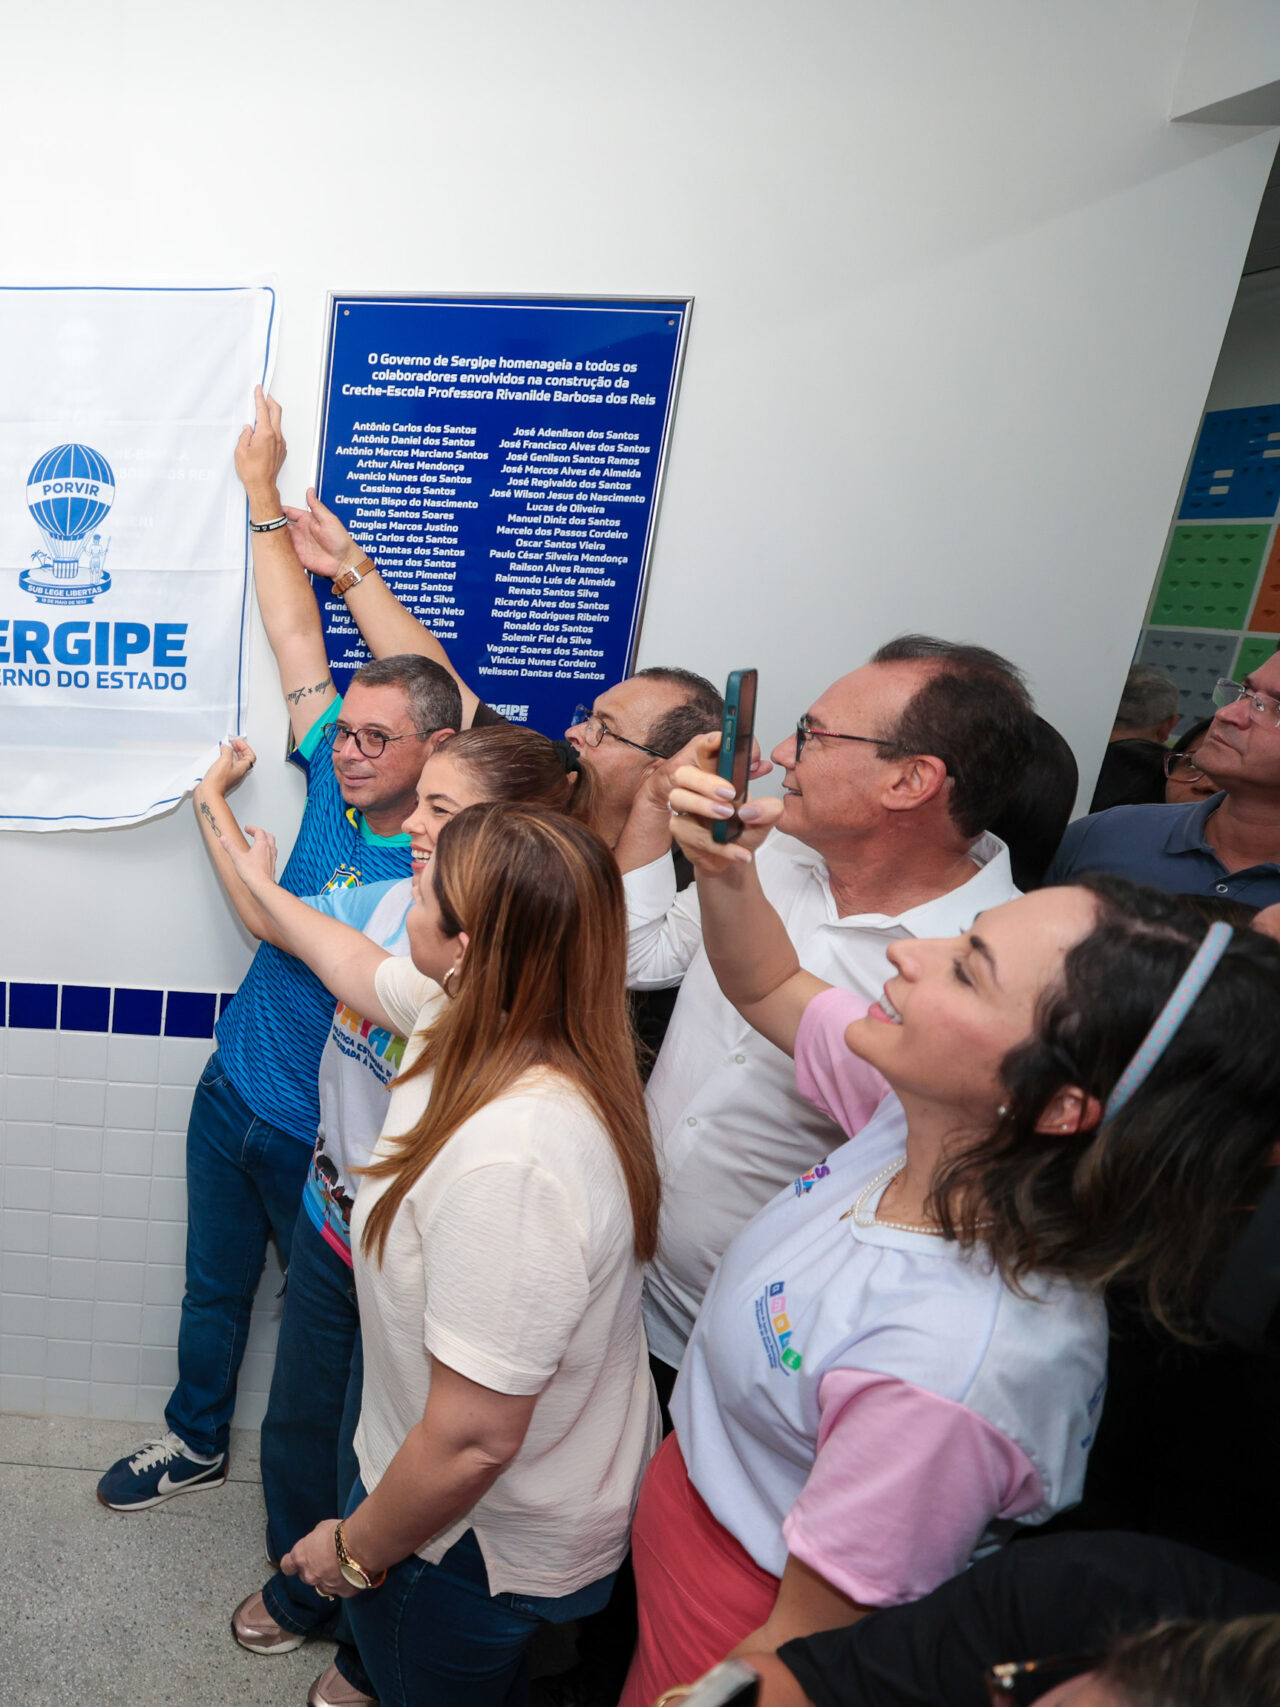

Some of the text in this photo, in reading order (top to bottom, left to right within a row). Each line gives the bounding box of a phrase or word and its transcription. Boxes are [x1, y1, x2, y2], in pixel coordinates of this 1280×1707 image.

[367, 353, 637, 373] O Governo de Sergipe homenageia a todos os
[371, 371, 629, 390] colaboradores envolvidos na construção da
[341, 384, 656, 405] Creche-Escola Professora Rivanilde Barbosa dos Reis
[353, 422, 476, 434] Antônio Carlos dos Santos
[514, 427, 639, 441] José Adenilson dos Santos
[351, 435, 475, 447] Antônio Daniel dos Santos
[499, 439, 650, 454] José Francisco Alves dos Santos
[336, 446, 488, 460] Antônio Marcos Marciano Santos
[506, 452, 639, 466] José Genilson Santos Ramos
[357, 459, 464, 474] Arthur Aires Mendonça
[501, 464, 641, 478] José Marcos Alves de Almeida
[388, 473, 472, 484] Nunes dos Santos
[508, 477, 529, 487] José
[579, 480, 596, 489] dos
[598, 480, 631, 491] Santos
[43, 482, 99, 496] PORVIR
[360, 484, 455, 496] Cassiano dos Santos
[490, 488, 645, 504] José Wilson Jesus do Nascimento
[335, 495, 478, 509] Cleverton Bispo do Nascimento
[526, 503, 604, 514] Lucas de Oliveira
[356, 508, 454, 520] Danilo Santos Soares
[508, 514, 620, 527] Manuel Diniz dos Santos
[349, 520, 458, 532] Douglas Marcos Justino
[496, 525, 628, 540] Marcelo dos Passos Cordeiro
[376, 532, 458, 545] Carlos dos Santos
[516, 538, 605, 551] Oscar Santos Vieira
[379, 545, 412, 555] Dantas
[414, 547, 431, 556] dos
[433, 547, 465, 557] Santos
[490, 549, 628, 566] Paulo César Silveira Mendonça
[405, 558, 456, 569] dos Santos
[546, 564, 571, 573] Alves
[573, 565, 604, 575] Ramos
[495, 573, 541, 584] Raimundo
[564, 576, 576, 585] de
[578, 577, 615, 587] Almeida
[28, 585, 102, 597] SUB LEGE LIBERTAS
[508, 586, 599, 599] Renato Santos Silva
[495, 598, 609, 611] Ricardo Alves dos Santos
[491, 609, 609, 623] Rodrigo Rodrigues Ribeiro
[326, 626, 358, 635] Jadson
[504, 621, 593, 634] Ronaldo dos Santos
[538, 634, 554, 644] Fiel
[556, 635, 567, 644] da
[570, 635, 591, 645] Silva
[344, 649, 364, 659] João
[486, 643, 603, 657] Vagner Soares dos Santos
[491, 655, 596, 669] Vinícius Nunes Cordeiro
[57, 670, 90, 688] DO
[96, 671, 187, 690] ESTADO
[478, 666, 604, 681] Welisson Dantas dos Santos
